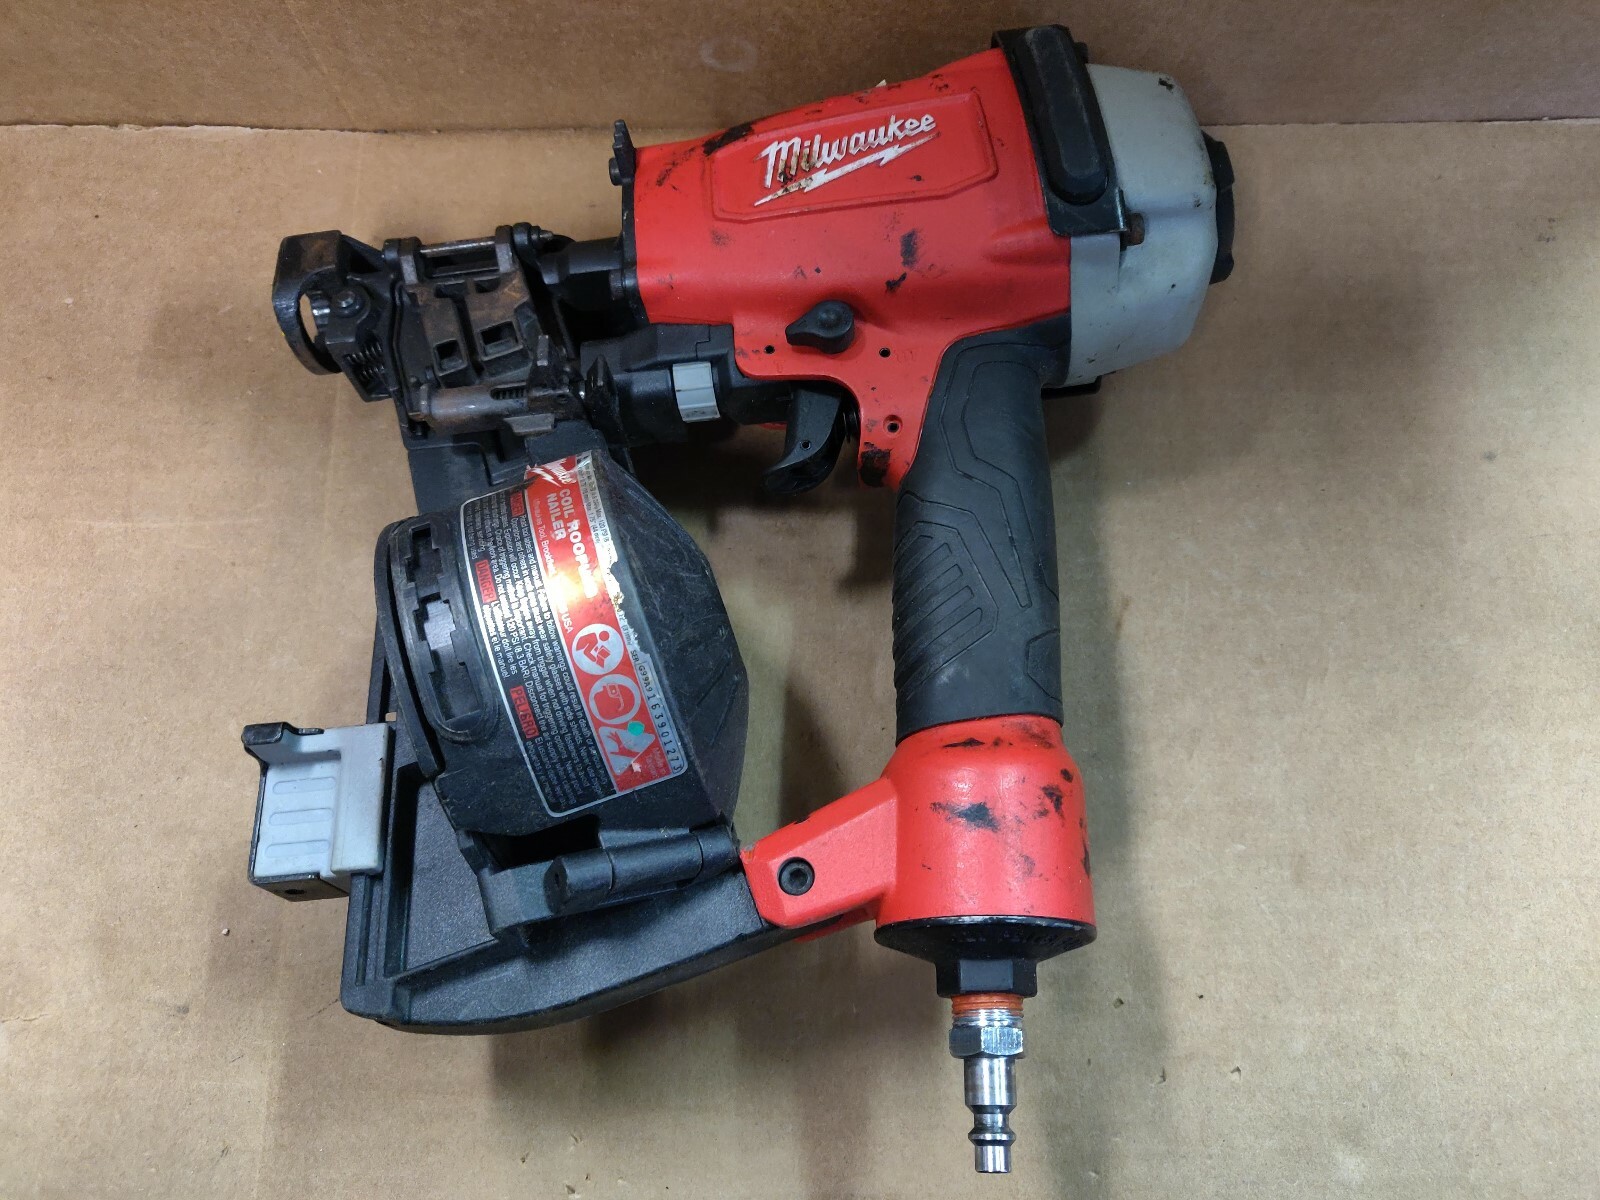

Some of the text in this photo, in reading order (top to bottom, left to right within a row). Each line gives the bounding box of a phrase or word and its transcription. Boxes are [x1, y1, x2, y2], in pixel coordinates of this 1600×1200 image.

[753, 113, 937, 189] Milwaukee
[558, 488, 576, 518] COIL
[519, 514, 528, 528] Read
[546, 492, 567, 540] NAILER
[494, 528, 503, 547] Choice
[510, 517, 521, 541] Operators
[522, 527, 530, 537] tool
[503, 528, 514, 553] Explosion
[515, 541, 524, 551] and
[524, 536, 534, 553] labels
[491, 559, 499, 574] area.
[499, 552, 510, 580] triggering
[508, 553, 516, 562] will
[518, 551, 527, 570] others
[527, 552, 537, 565] and
[565, 518, 600, 599] ROOF
[476, 561, 495, 601] DANGER
[494, 573, 502, 583] Do
[510, 562, 520, 581] occur.
[538, 525, 547, 540] Tool,
[561, 613, 575, 633] USA
[497, 583, 506, 595] not
[531, 606, 543, 624] must
[543, 611, 552, 619] to
[506, 618, 517, 632] 120
[537, 624, 548, 641] wear
[545, 619, 557, 640] follow
[510, 631, 520, 645] PSI
[531, 638, 542, 656] from
[493, 644, 502, 652] le
[501, 638, 512, 652] doit
[509, 663, 519, 675] les
[513, 644, 525, 659] (8.3
[522, 642, 537, 665] Check
[542, 642, 555, 664] safety
[552, 640, 567, 672] warnings
[630, 649, 639, 662] SER
[495, 652, 511, 680] manuel.
[518, 659, 531, 681] BAR).
[537, 655, 550, 679] trigger
[530, 665, 545, 692] manual
[548, 663, 564, 690] glasses
[562, 671, 574, 691] could
[539, 691, 549, 702] for
[544, 679, 557, 698] when
[525, 681, 545, 719] Disconnect
[551, 698, 563, 710] not
[558, 691, 570, 706] with
[568, 691, 581, 711] result
[511, 688, 537, 736] PELIGRO
[542, 702, 559, 735] triggering
[555, 709, 570, 734] driving
[563, 705, 575, 721] side
[539, 719, 549, 731] the
[578, 718, 592, 738] death
[534, 736, 544, 745] El
[542, 731, 552, 741] air
[546, 741, 560, 763] supply
[564, 733, 580, 764] fasteners
